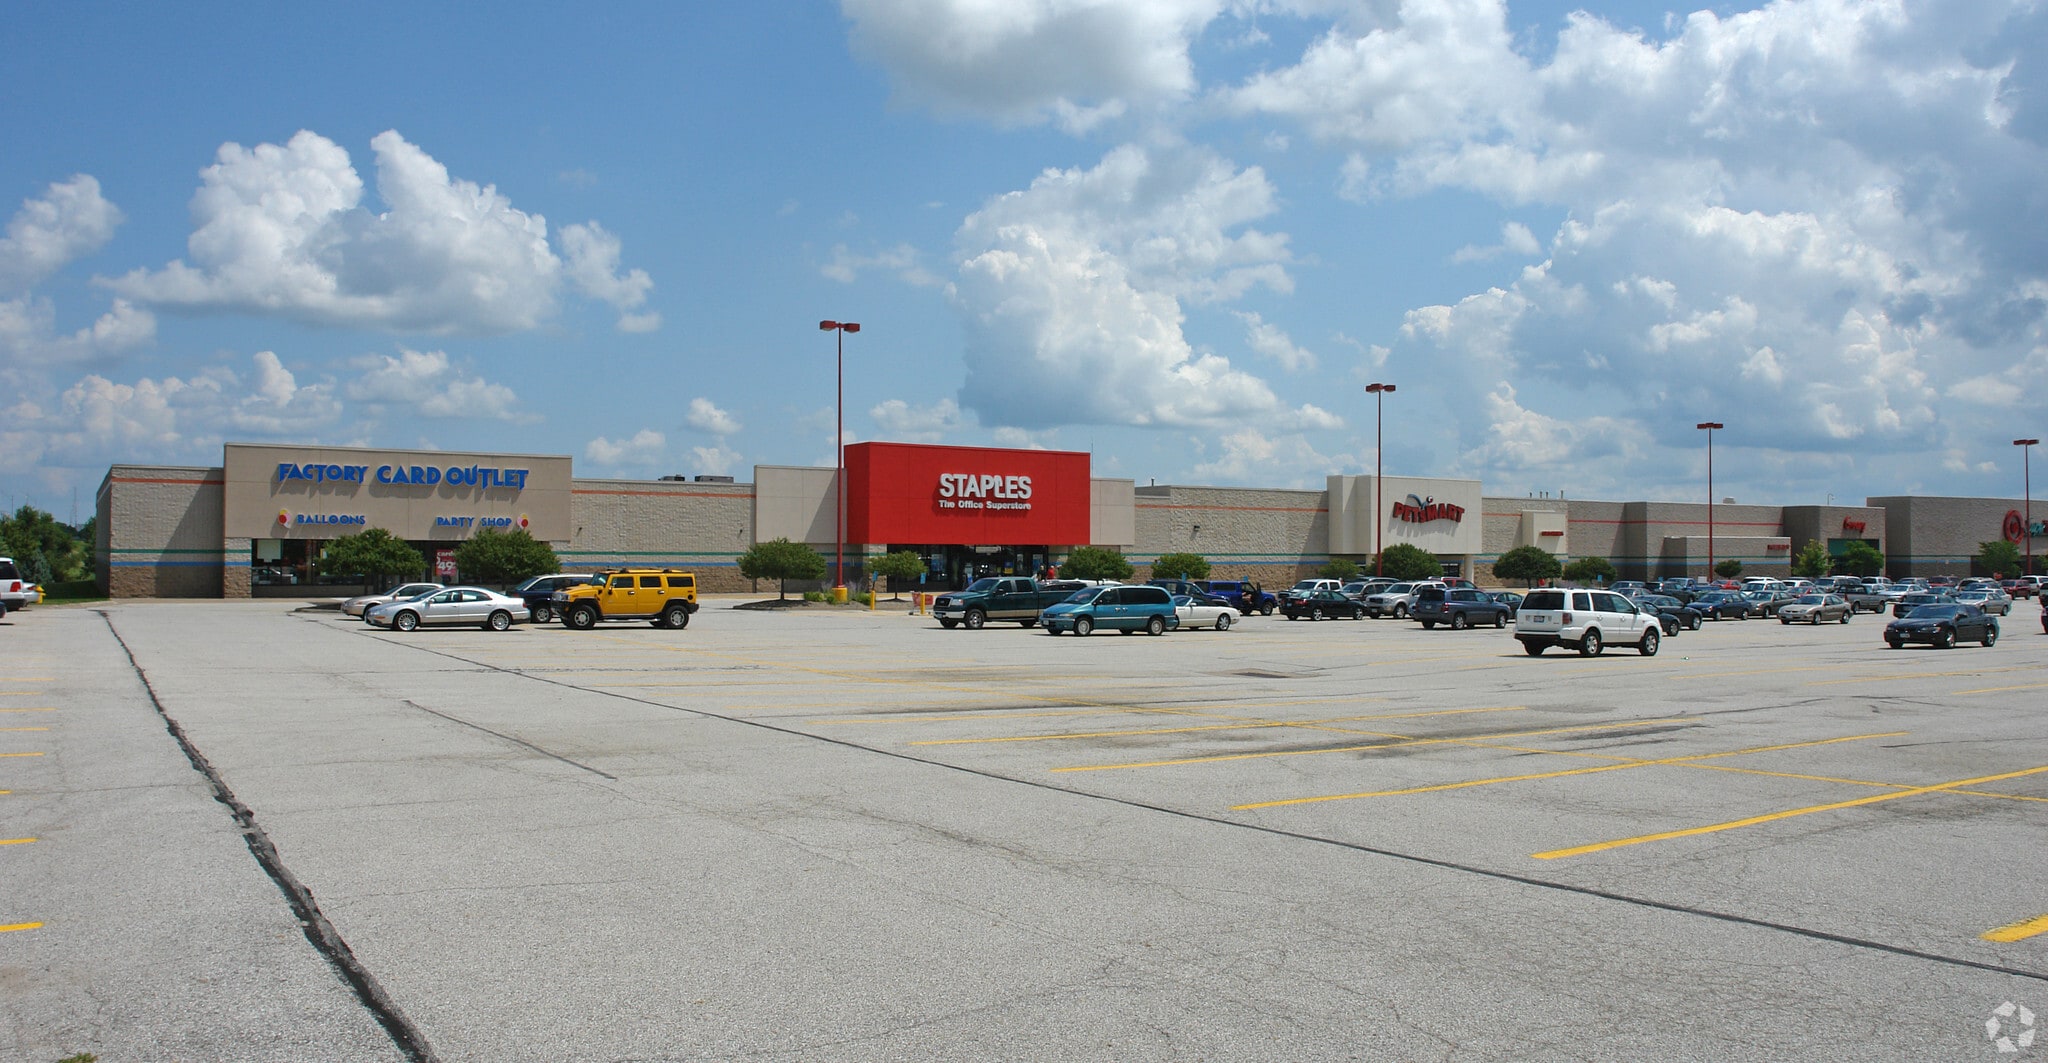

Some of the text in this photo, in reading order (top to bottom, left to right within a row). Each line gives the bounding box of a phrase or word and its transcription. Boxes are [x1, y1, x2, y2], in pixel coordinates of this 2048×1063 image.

[278, 463, 529, 491] FACTORY CARD OUTLET
[939, 473, 1032, 500] STAPLES
[939, 500, 1032, 511] The Office Superstore
[296, 514, 366, 525] BALLOONS
[436, 516, 512, 528] PARTY SHOP
